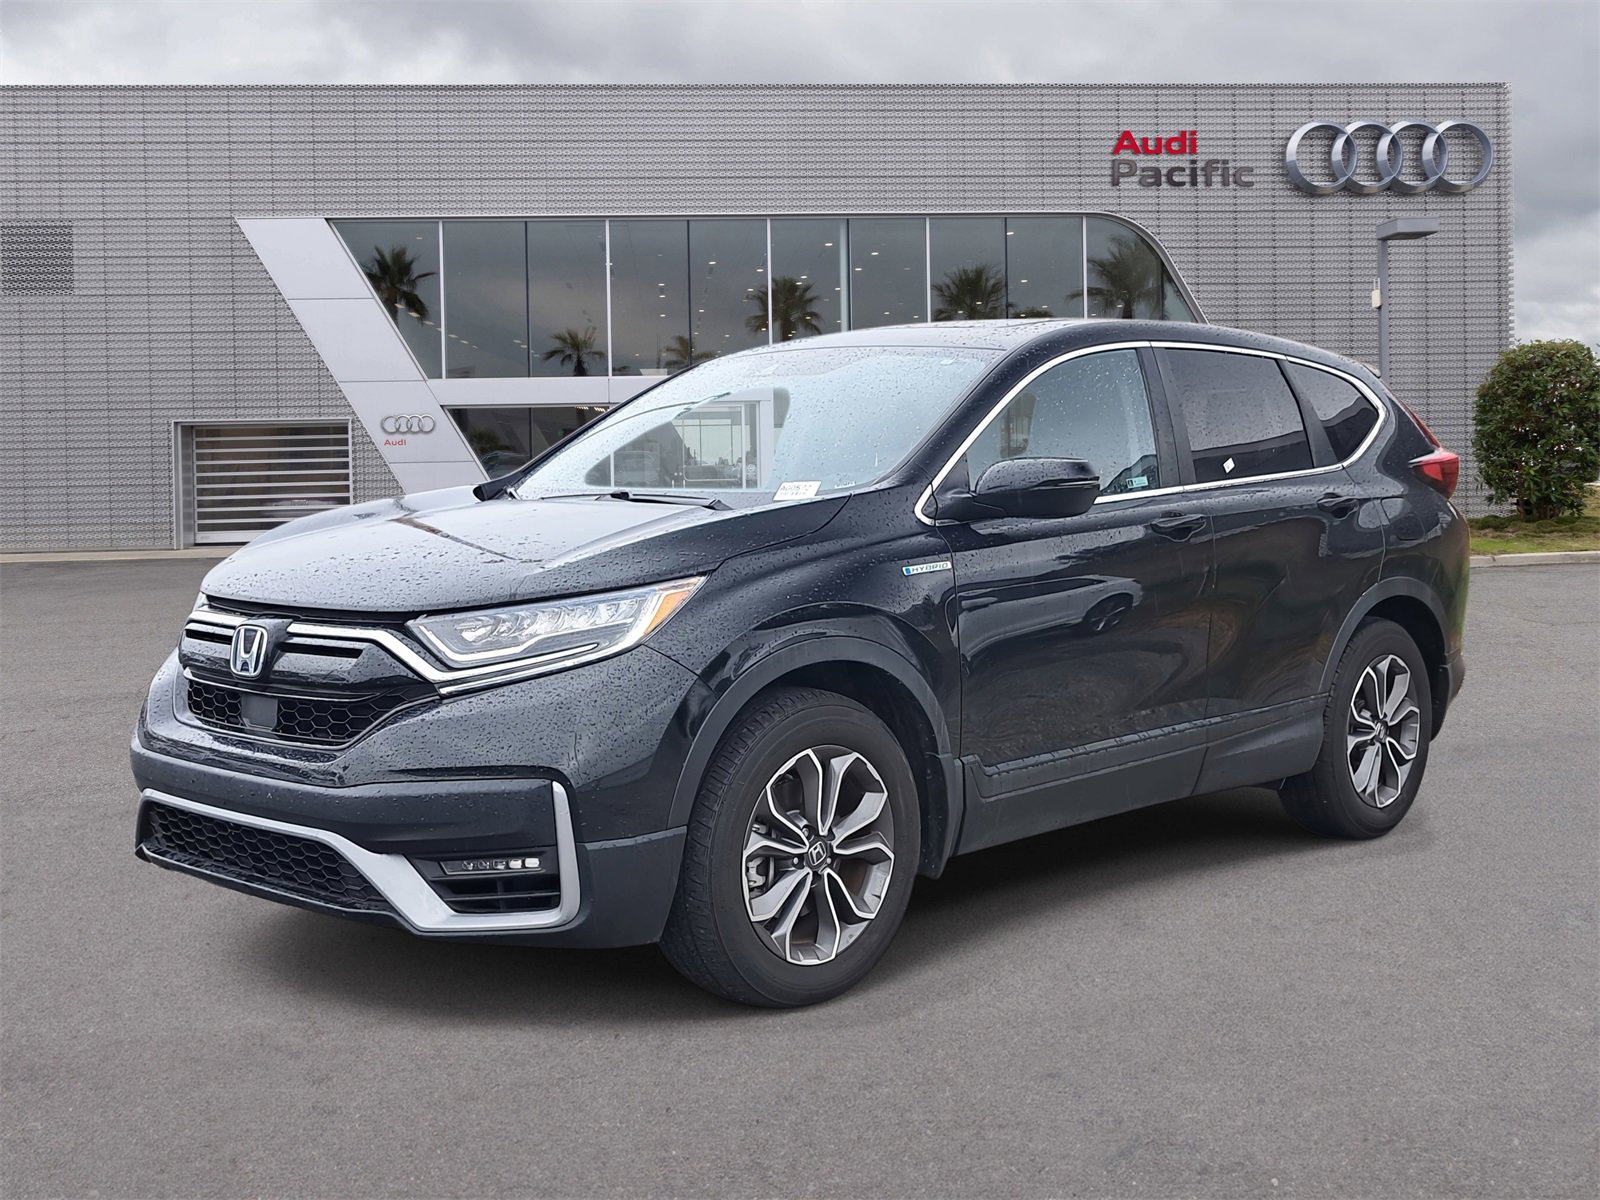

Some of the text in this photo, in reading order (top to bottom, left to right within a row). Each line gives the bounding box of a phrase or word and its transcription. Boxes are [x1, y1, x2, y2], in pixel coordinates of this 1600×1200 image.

[1112, 130, 1197, 155] Audi
[1111, 159, 1255, 187] Pacific
[912, 562, 949, 573] HYBRID
